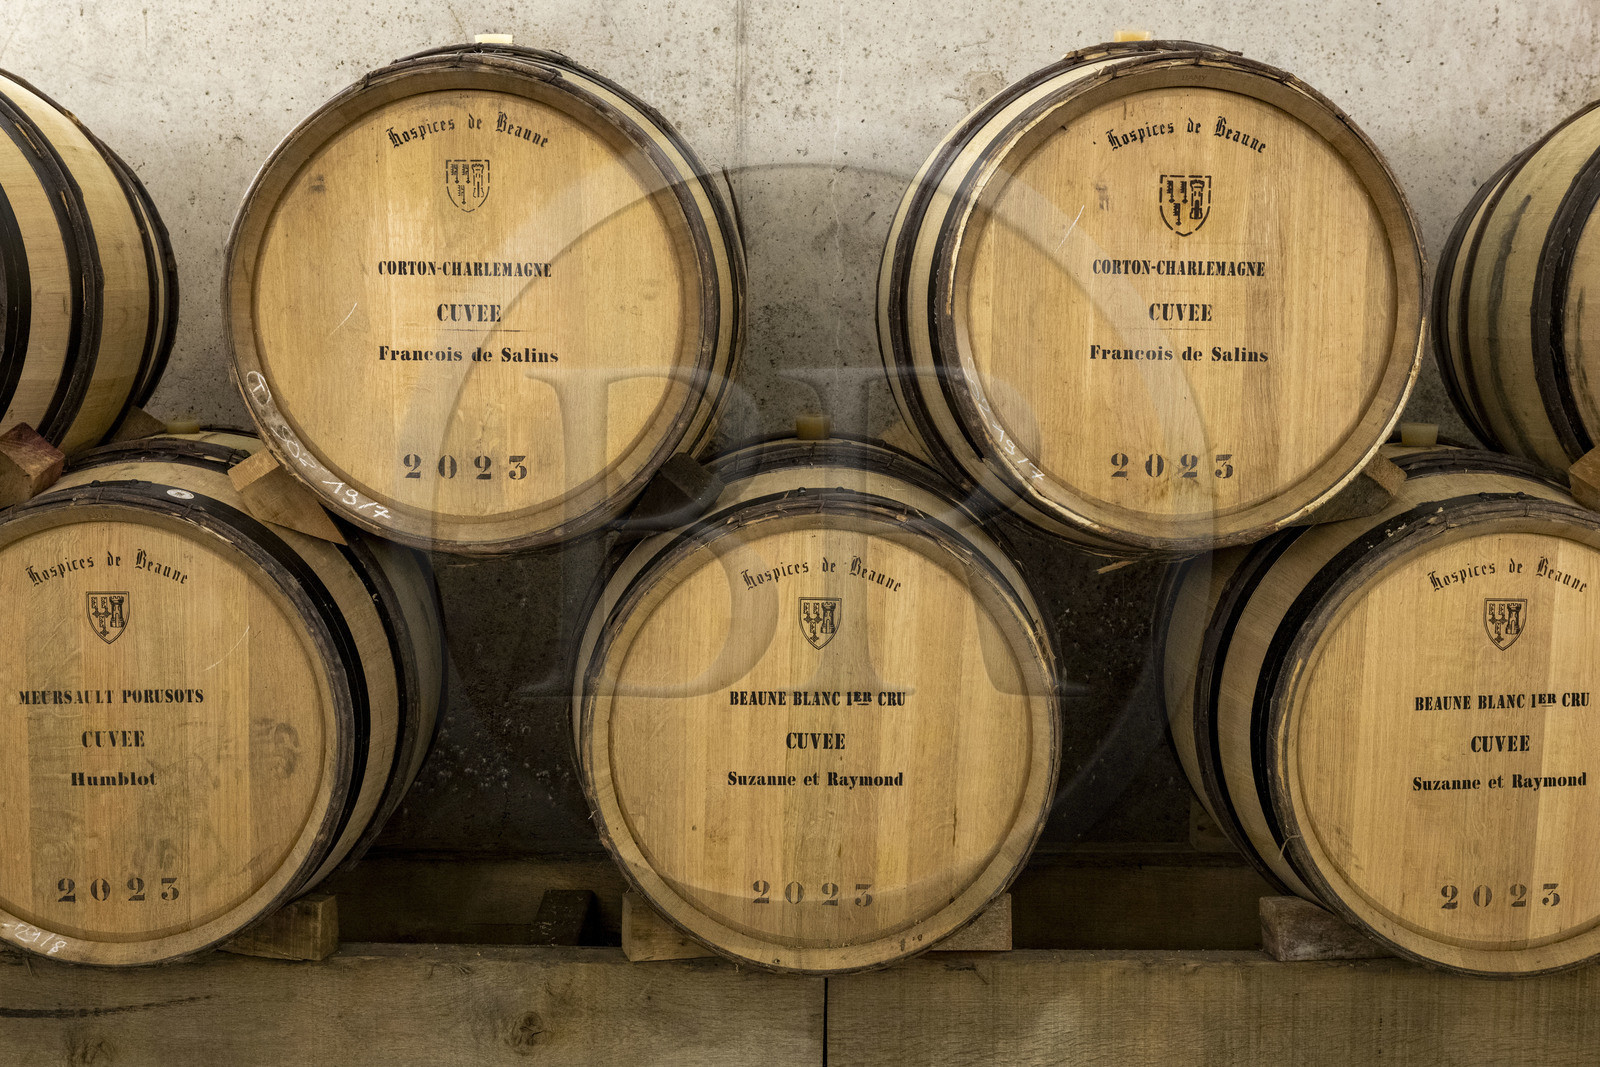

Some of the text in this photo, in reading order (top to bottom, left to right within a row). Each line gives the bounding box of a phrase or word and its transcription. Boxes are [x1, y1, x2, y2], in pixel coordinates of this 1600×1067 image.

[387, 111, 549, 149] Hospices de Beaune
[1105, 115, 1266, 154] Hospices de Beaune
[378, 260, 553, 278] CORTON-CHARLEMAGNE
[1092, 259, 1266, 277] CORTON-CHARLEMAGNE
[436, 303, 502, 323] CUVEE
[1149, 303, 1213, 322] CUVEE
[379, 345, 559, 363] Francois de Salins
[1090, 344, 1269, 363] Francois de Salins
[403, 453, 528, 481] 2023
[1110, 452, 1234, 481] 2023
[26, 548, 188, 587] Hospices de Beaune
[741, 556, 902, 593] Hospices de Beaune
[1427, 556, 1588, 593] Hospices de Beaune
[19, 689, 204, 705] MEURSAULT PORUSOTS
[729, 690, 787, 706] BEAUNE
[792, 691, 841, 706] BLANC
[877, 691, 906, 707] CRU
[1415, 695, 1471, 711] BEAUNE
[1477, 693, 1525, 710] BLANC
[1562, 693, 1590, 708] CRU
[81, 730, 145, 748] CUVEE
[785, 732, 846, 750] CUVEE
[1470, 734, 1530, 753] CUVEE
[72, 771, 157, 786] Humblot
[727, 771, 903, 789] Suzanne et Raymond
[1412, 771, 1587, 792] Suzanne et Raymond
[57, 877, 180, 904] 2023
[752, 880, 874, 907] 2023
[1440, 883, 1561, 910] 2023
